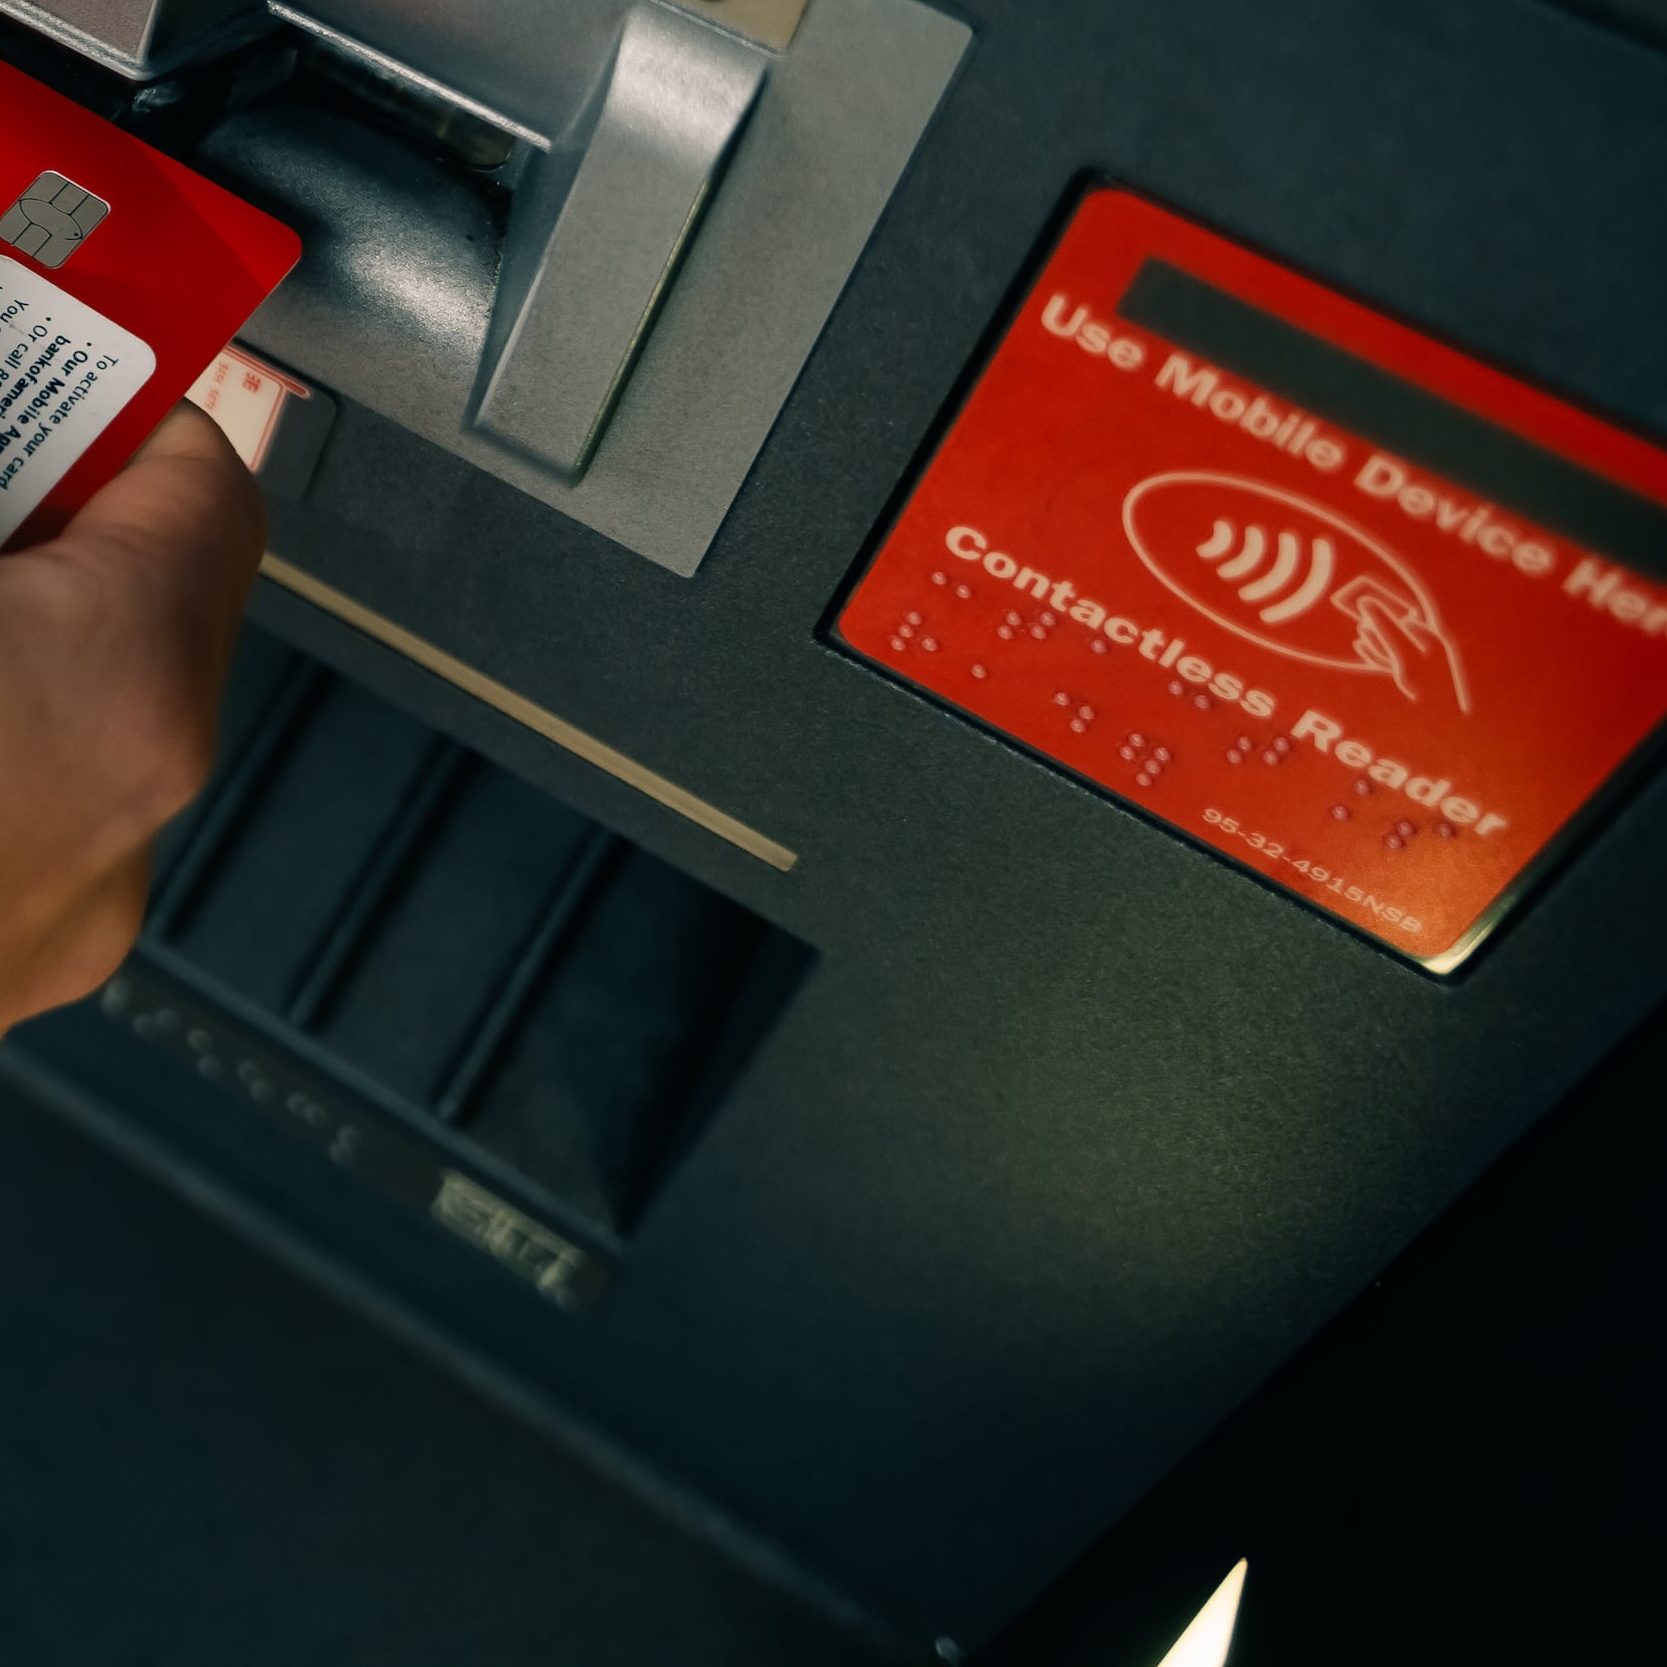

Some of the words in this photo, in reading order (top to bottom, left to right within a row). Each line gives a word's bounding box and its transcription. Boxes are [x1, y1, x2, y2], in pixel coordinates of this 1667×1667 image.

[0, 300, 29, 327] You
[28, 325, 47, 342] Or
[5, 344, 29, 369] call
[61, 350, 88, 376] Our
[95, 354, 119, 371] To
[17, 377, 65, 424] Mobile
[49, 372, 97, 424] activate
[23, 422, 52, 458] your
[1040, 294, 1147, 372] Use
[1154, 353, 1345, 473] Mobile
[1354, 455, 1553, 576] Device
[1564, 558, 1667, 635] Her
[943, 526, 1275, 720] Contactless
[1291, 709, 1509, 837] Reader
[1202, 808, 1422, 932] 95-32-4915NSB
